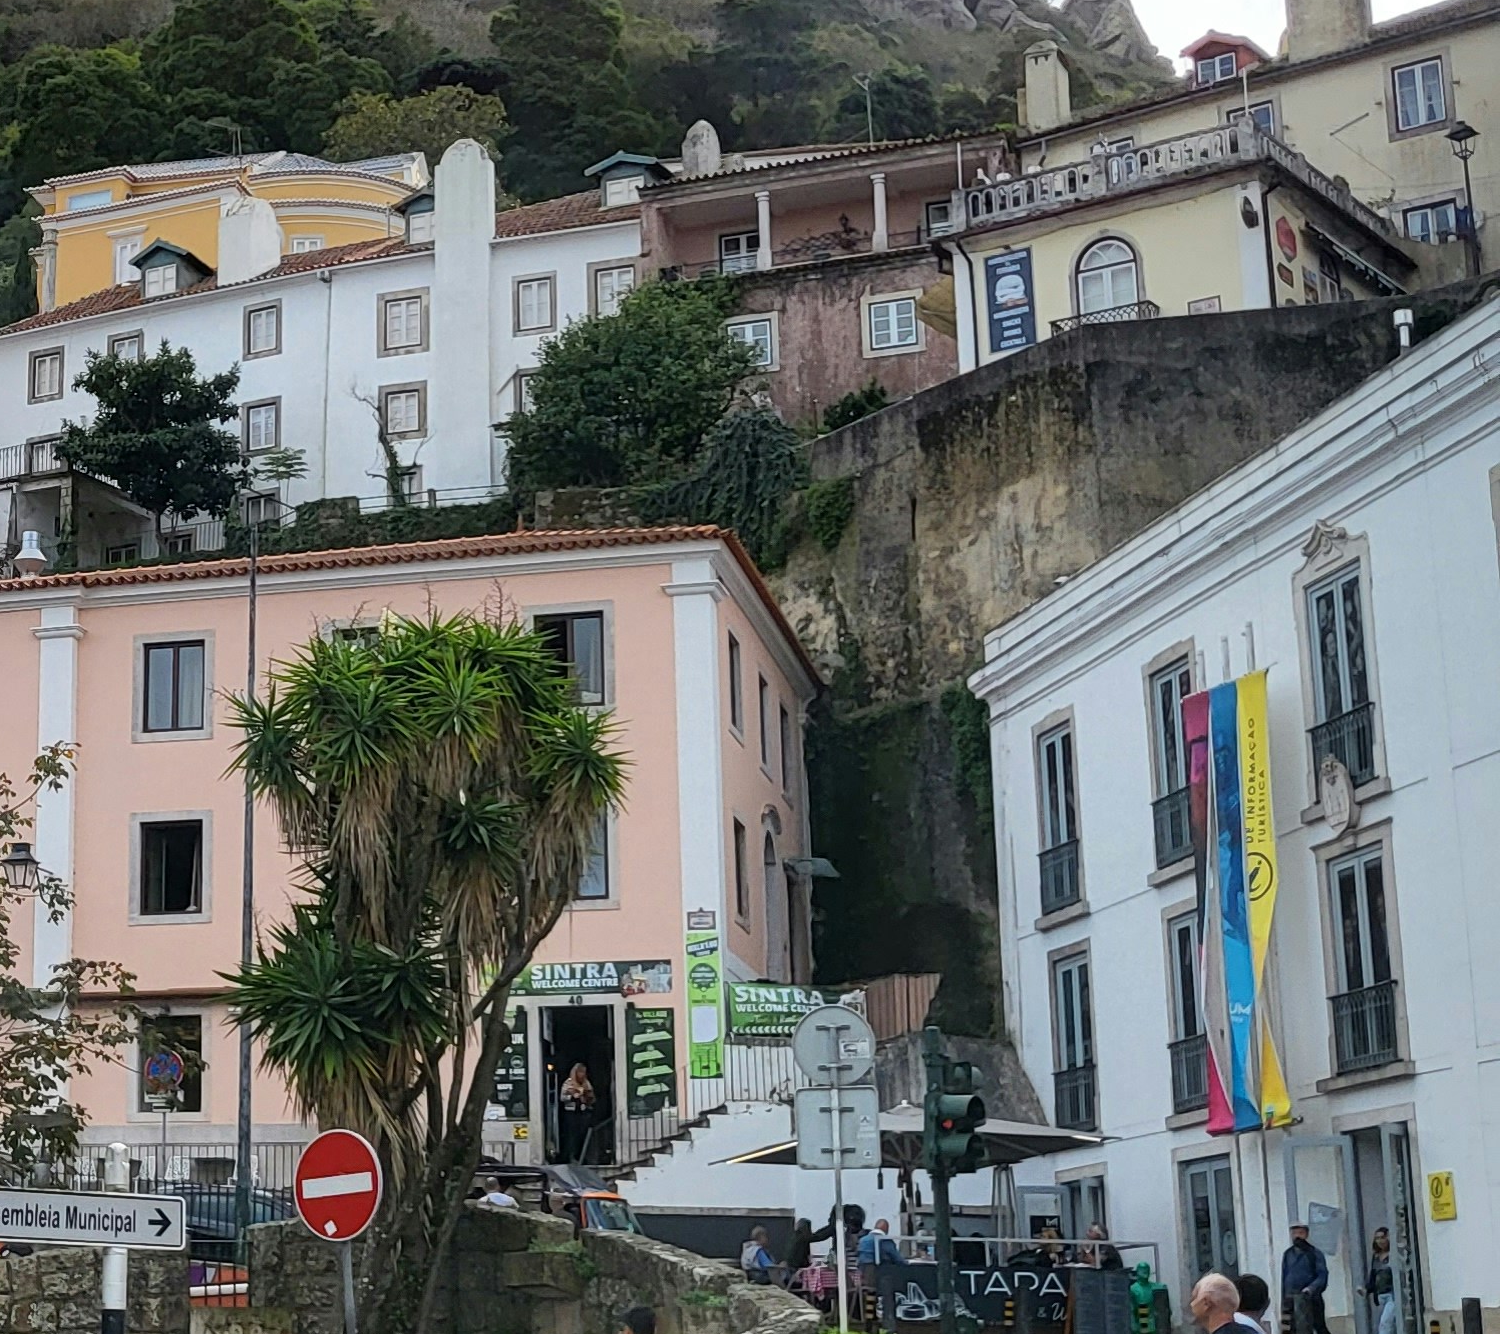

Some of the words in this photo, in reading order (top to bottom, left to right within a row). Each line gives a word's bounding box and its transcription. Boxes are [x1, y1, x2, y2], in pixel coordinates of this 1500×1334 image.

[530, 963, 618, 980] SINTRA
[531, 979, 580, 989] WELCOME
[582, 977, 619, 988] CENTRE
[568, 995, 583, 1005] 40
[734, 986, 824, 1005] SINTRA
[735, 1003, 788, 1013] WELCOME
[65, 1205, 136, 1238] Municipal
